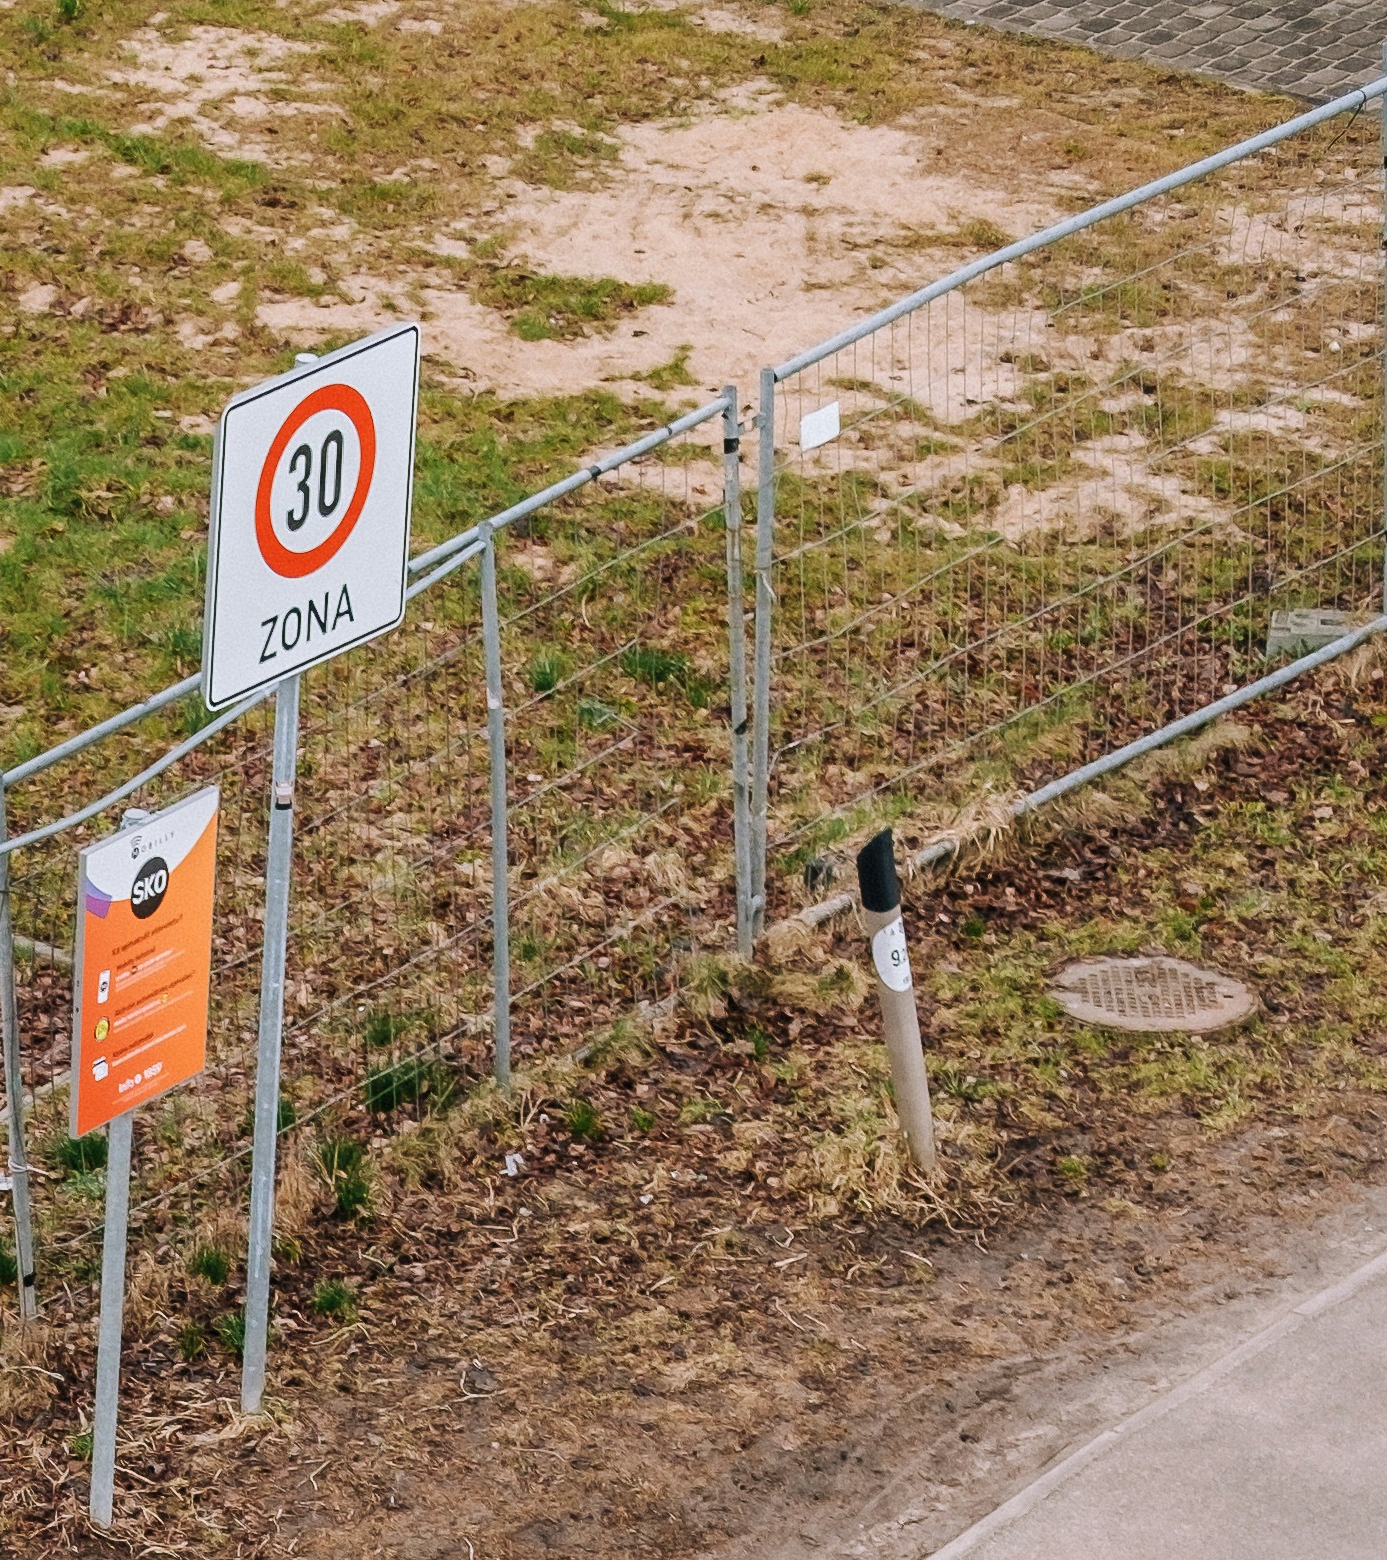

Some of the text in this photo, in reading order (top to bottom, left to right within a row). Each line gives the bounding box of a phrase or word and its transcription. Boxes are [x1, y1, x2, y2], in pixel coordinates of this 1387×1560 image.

[287, 429, 344, 532] 30
[259, 583, 354, 664] ZONA
[132, 869, 168, 905] SKO
